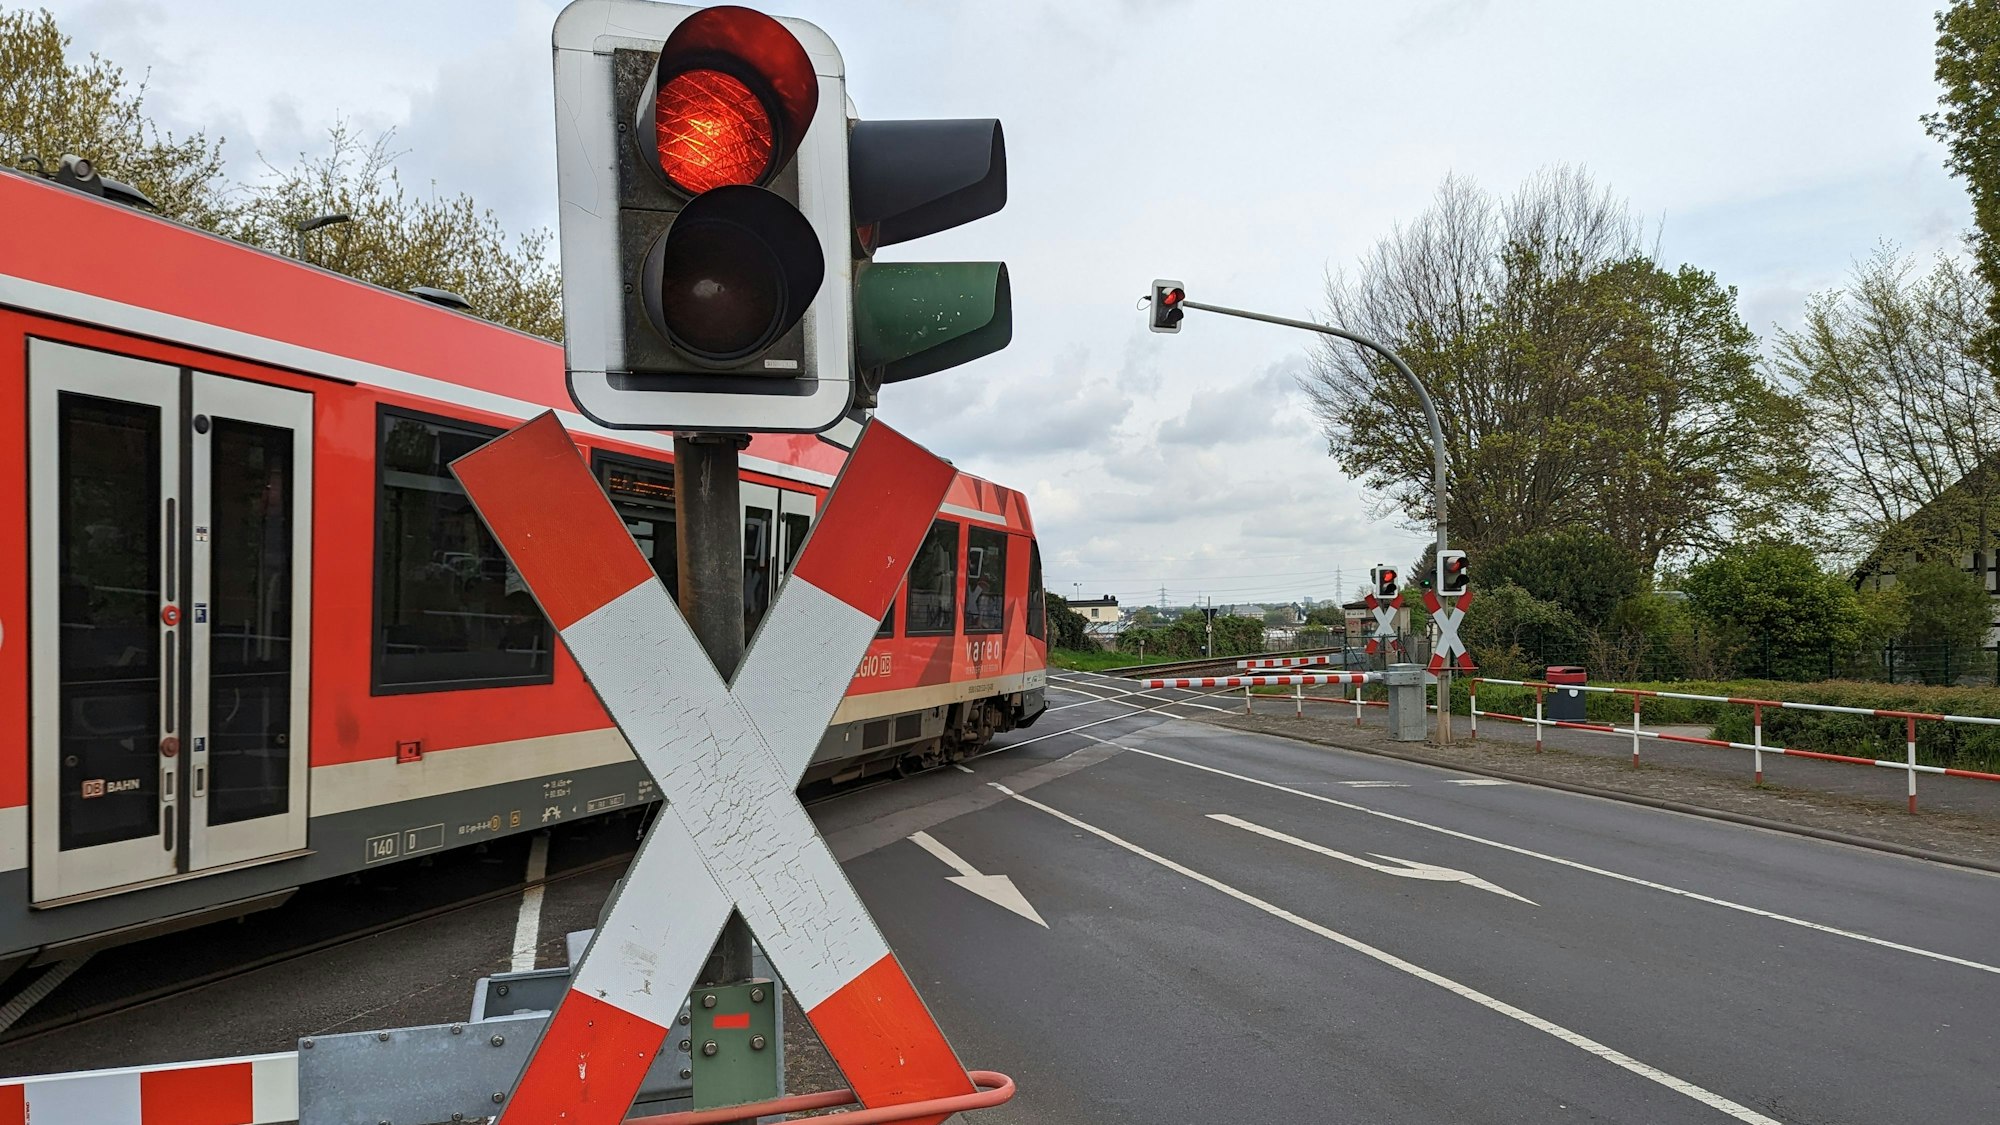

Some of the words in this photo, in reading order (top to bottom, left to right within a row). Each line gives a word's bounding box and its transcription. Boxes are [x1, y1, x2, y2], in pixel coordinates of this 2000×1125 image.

[966, 640, 1000, 662] vareo
[854, 655, 879, 677] GIO
[880, 654, 891, 676] DB
[83, 780, 104, 797] DB
[107, 779, 140, 793] BAHN
[373, 838, 393, 857] 140
[409, 834, 416, 849] D
